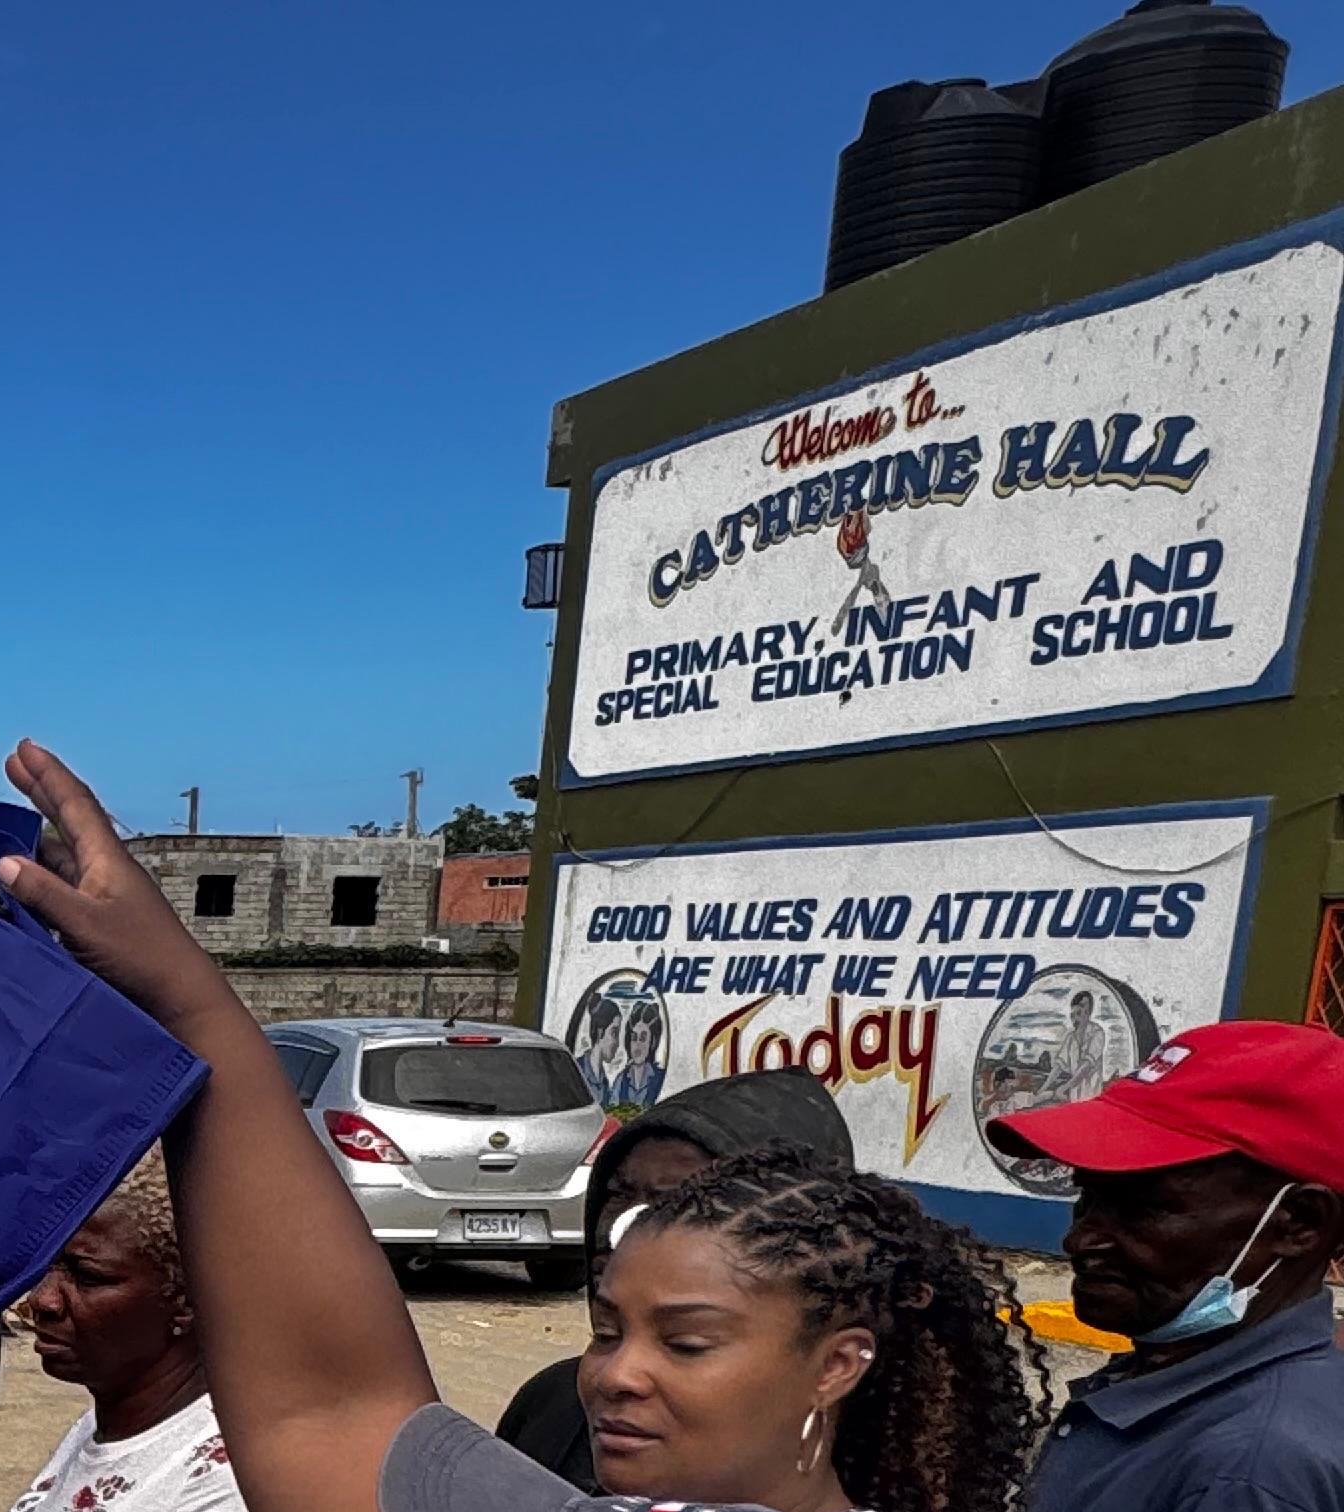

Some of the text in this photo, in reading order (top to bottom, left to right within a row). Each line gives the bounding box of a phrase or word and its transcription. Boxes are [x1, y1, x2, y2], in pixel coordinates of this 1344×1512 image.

[761, 405, 898, 470] Welcome
[648, 412, 1210, 609] CATHERINE HALL
[594, 590, 1234, 727] SPECIAL EDUCATION SCHOOL
[624, 538, 1224, 686] PRIMARY, INFANT AND
[586, 881, 1207, 944] GOOD VALUES AND ATTITUDES
[639, 952, 1037, 1001] ARE WHAT WE NEED
[701, 990, 952, 1170] Today
